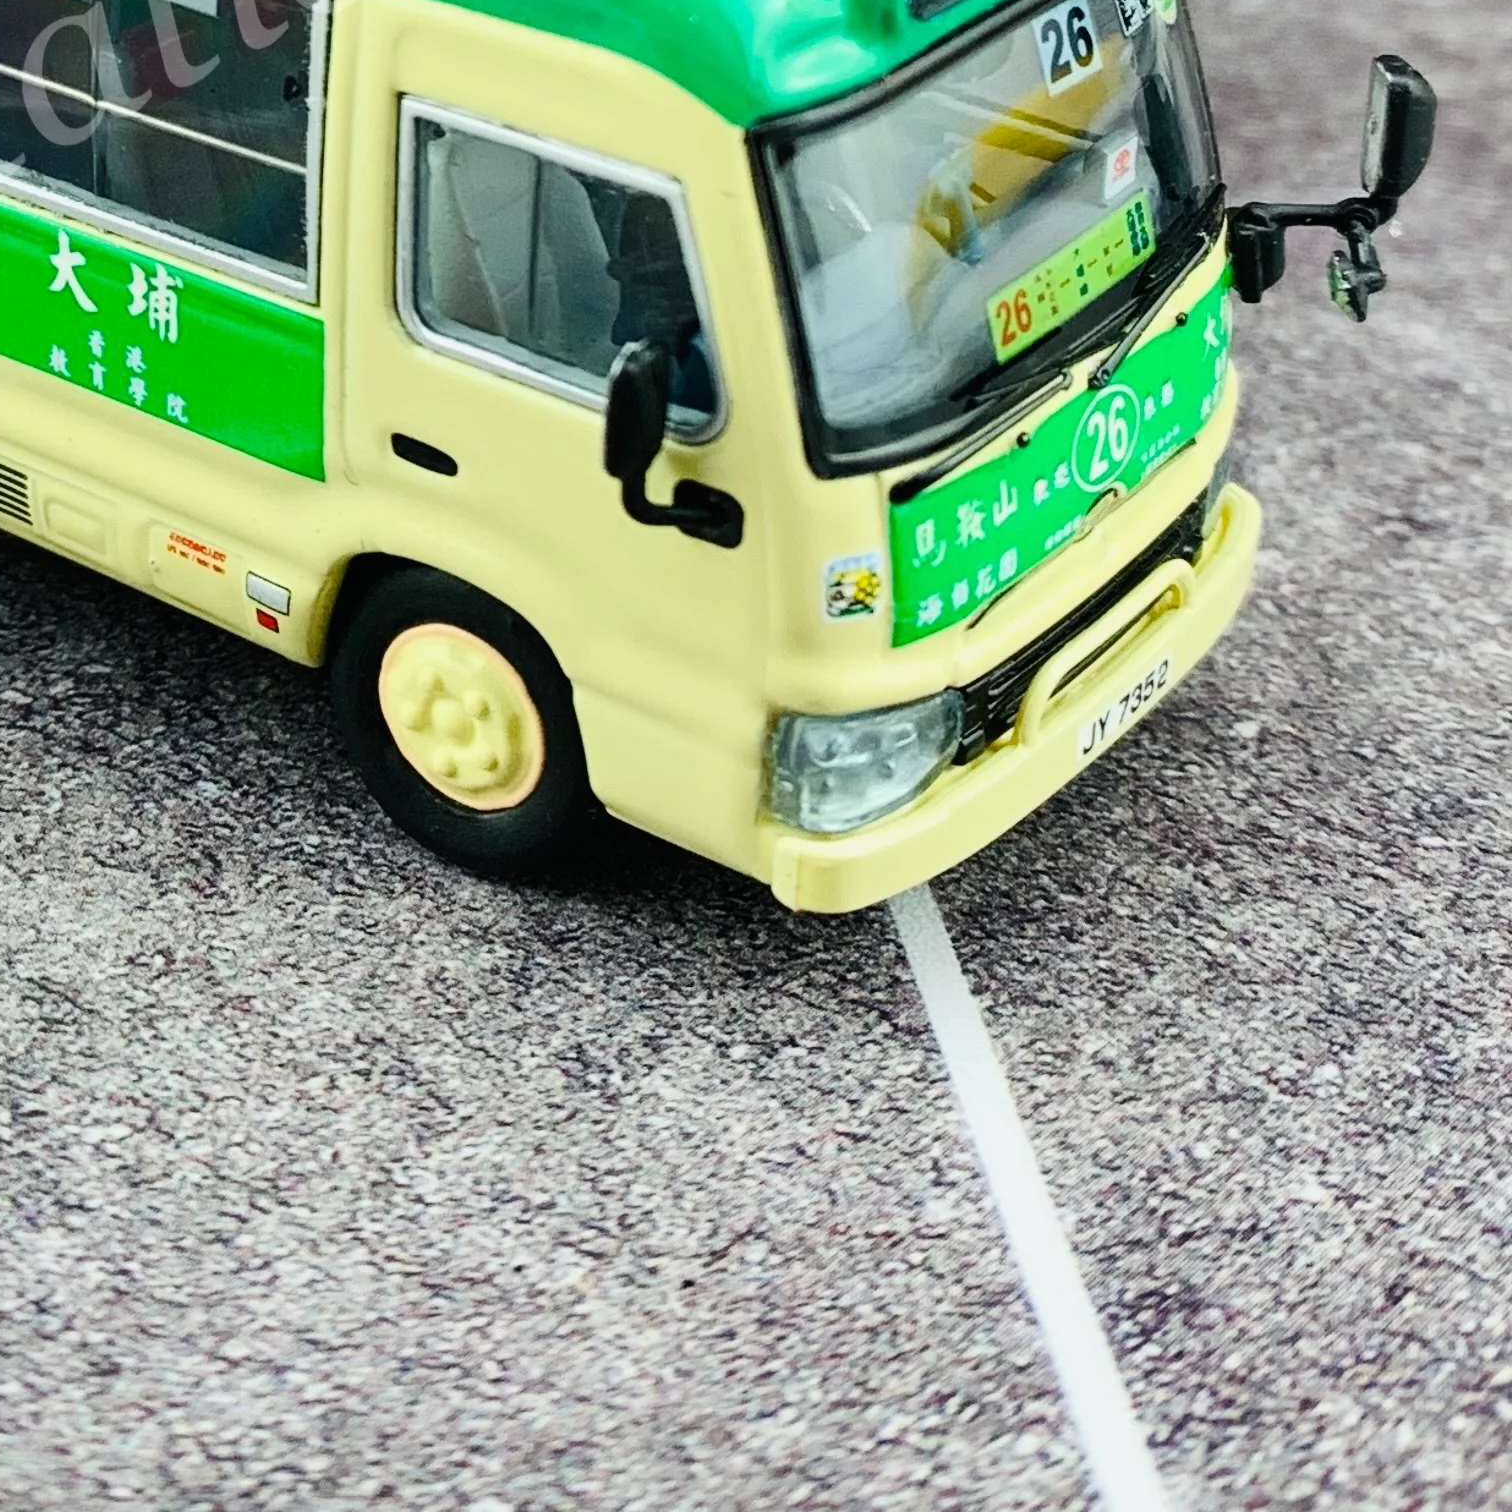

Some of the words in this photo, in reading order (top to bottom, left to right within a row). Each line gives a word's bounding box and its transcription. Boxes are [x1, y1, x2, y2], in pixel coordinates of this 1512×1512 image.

[1041, 6, 1093, 84] 26
[48, 228, 185, 344] 大埔
[995, 289, 1032, 348] 26
[1087, 395, 1129, 482] 26
[1083, 709, 1110, 755] JY
[1119, 658, 1168, 724] 7352
